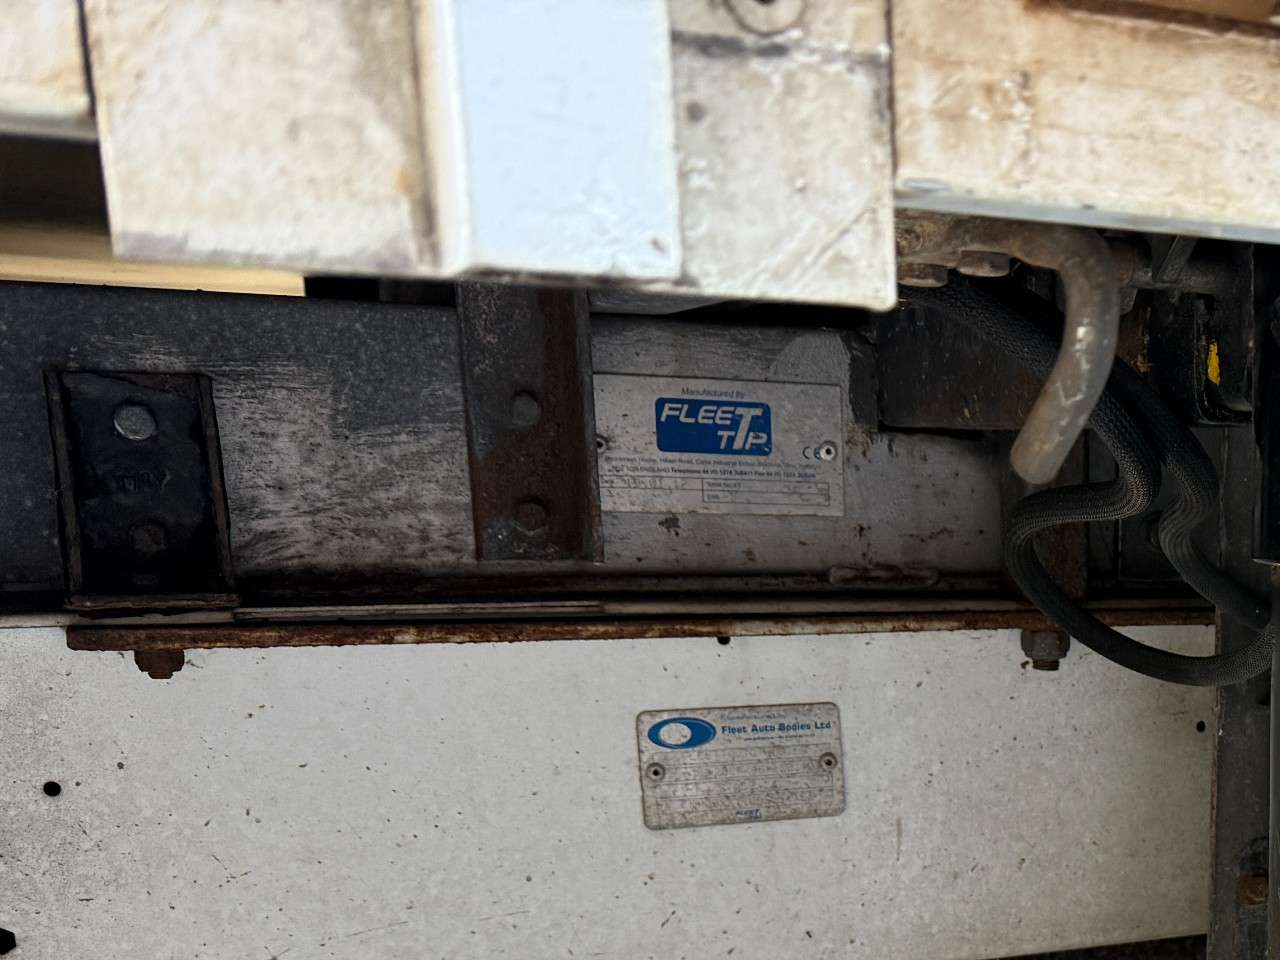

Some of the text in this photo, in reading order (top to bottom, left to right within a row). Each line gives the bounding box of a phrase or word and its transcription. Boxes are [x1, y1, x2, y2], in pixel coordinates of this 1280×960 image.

[721, 721, 831, 735] Fleet Auto Bodies Ltd
